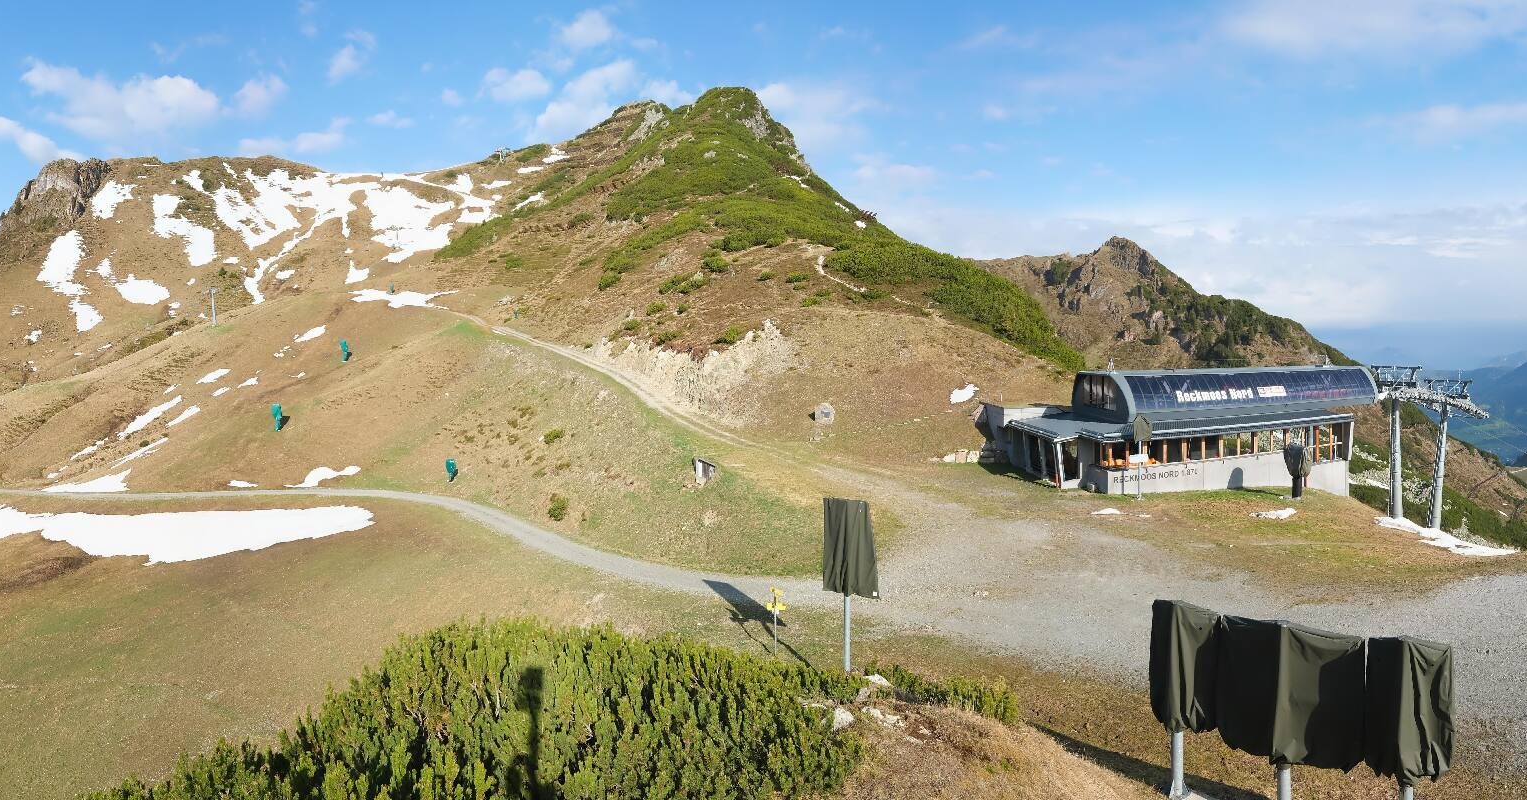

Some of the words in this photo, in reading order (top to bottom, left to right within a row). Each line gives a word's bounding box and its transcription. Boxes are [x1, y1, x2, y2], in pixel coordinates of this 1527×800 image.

[1176, 390, 1227, 403] Reckmoos
[1229, 387, 1254, 399] Nord
[1159, 470, 1179, 479] NORD
